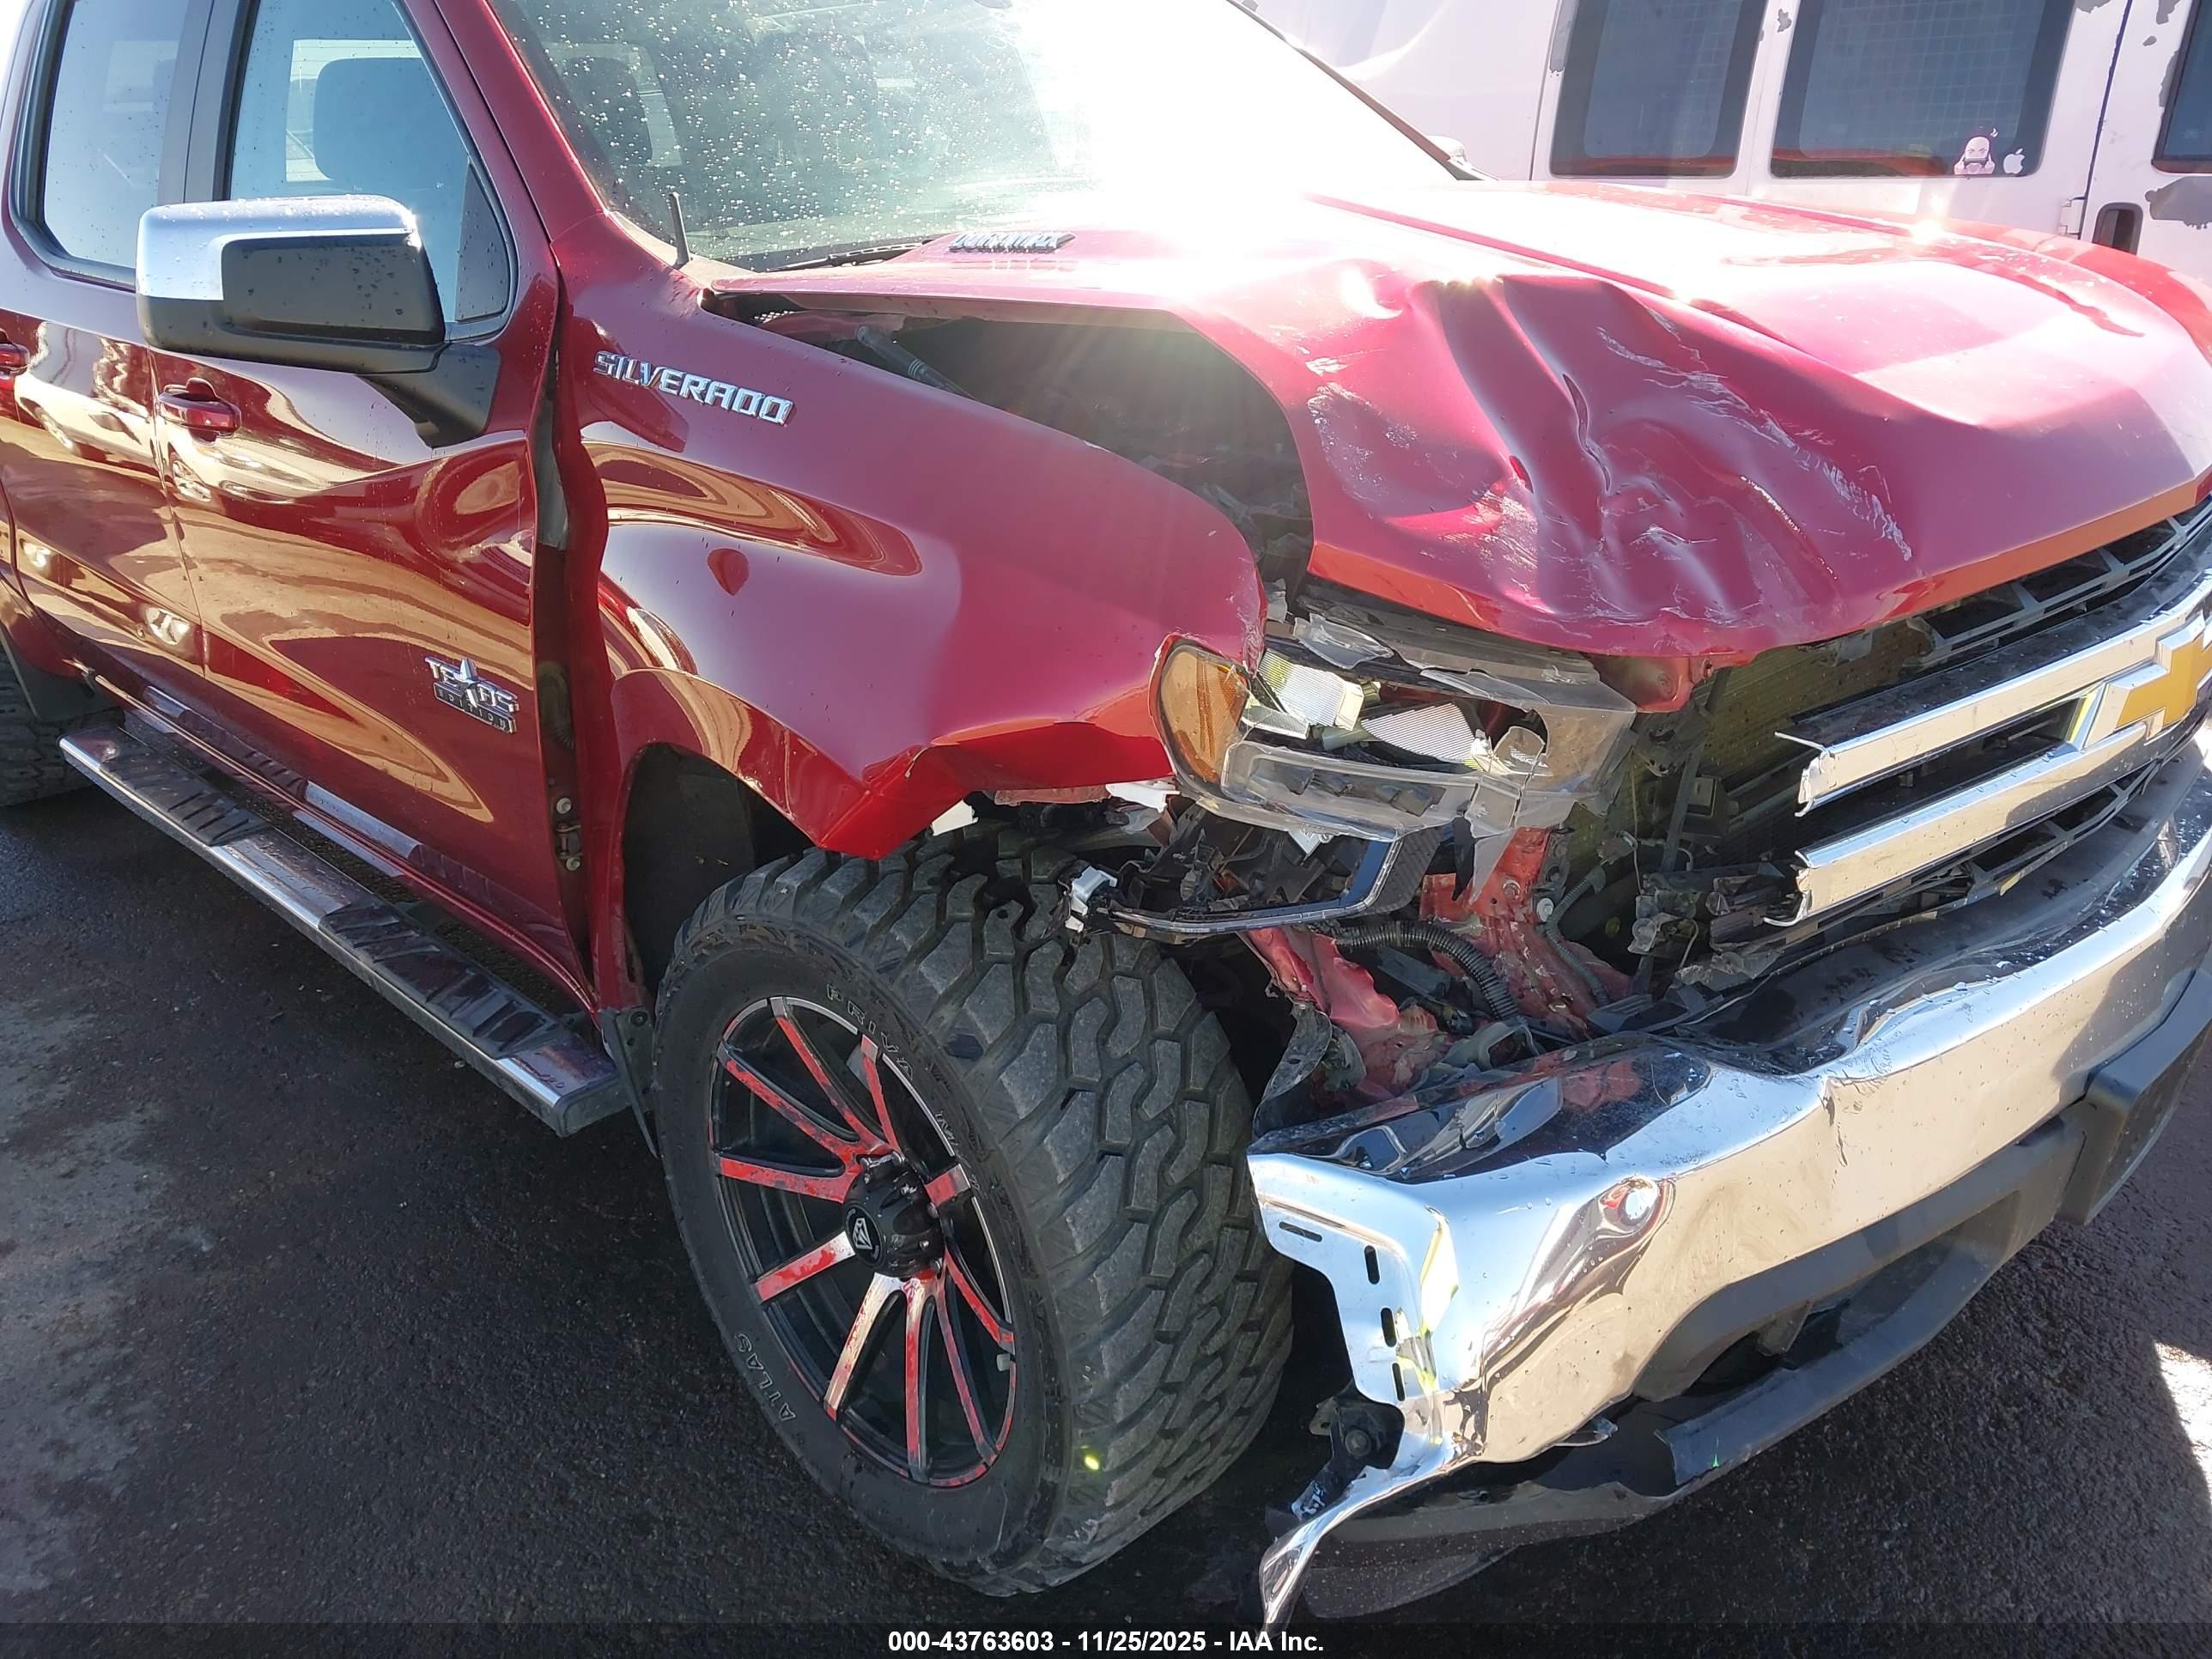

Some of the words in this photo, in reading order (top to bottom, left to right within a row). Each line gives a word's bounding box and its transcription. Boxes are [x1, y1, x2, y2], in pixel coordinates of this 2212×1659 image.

[593, 351, 793, 426] SILVERADO
[425, 657, 519, 713] TEXAS
[437, 687, 508, 729] EDITION
[826, 983, 915, 1081] PRIVA
[734, 1333, 797, 1421] ATLAS
